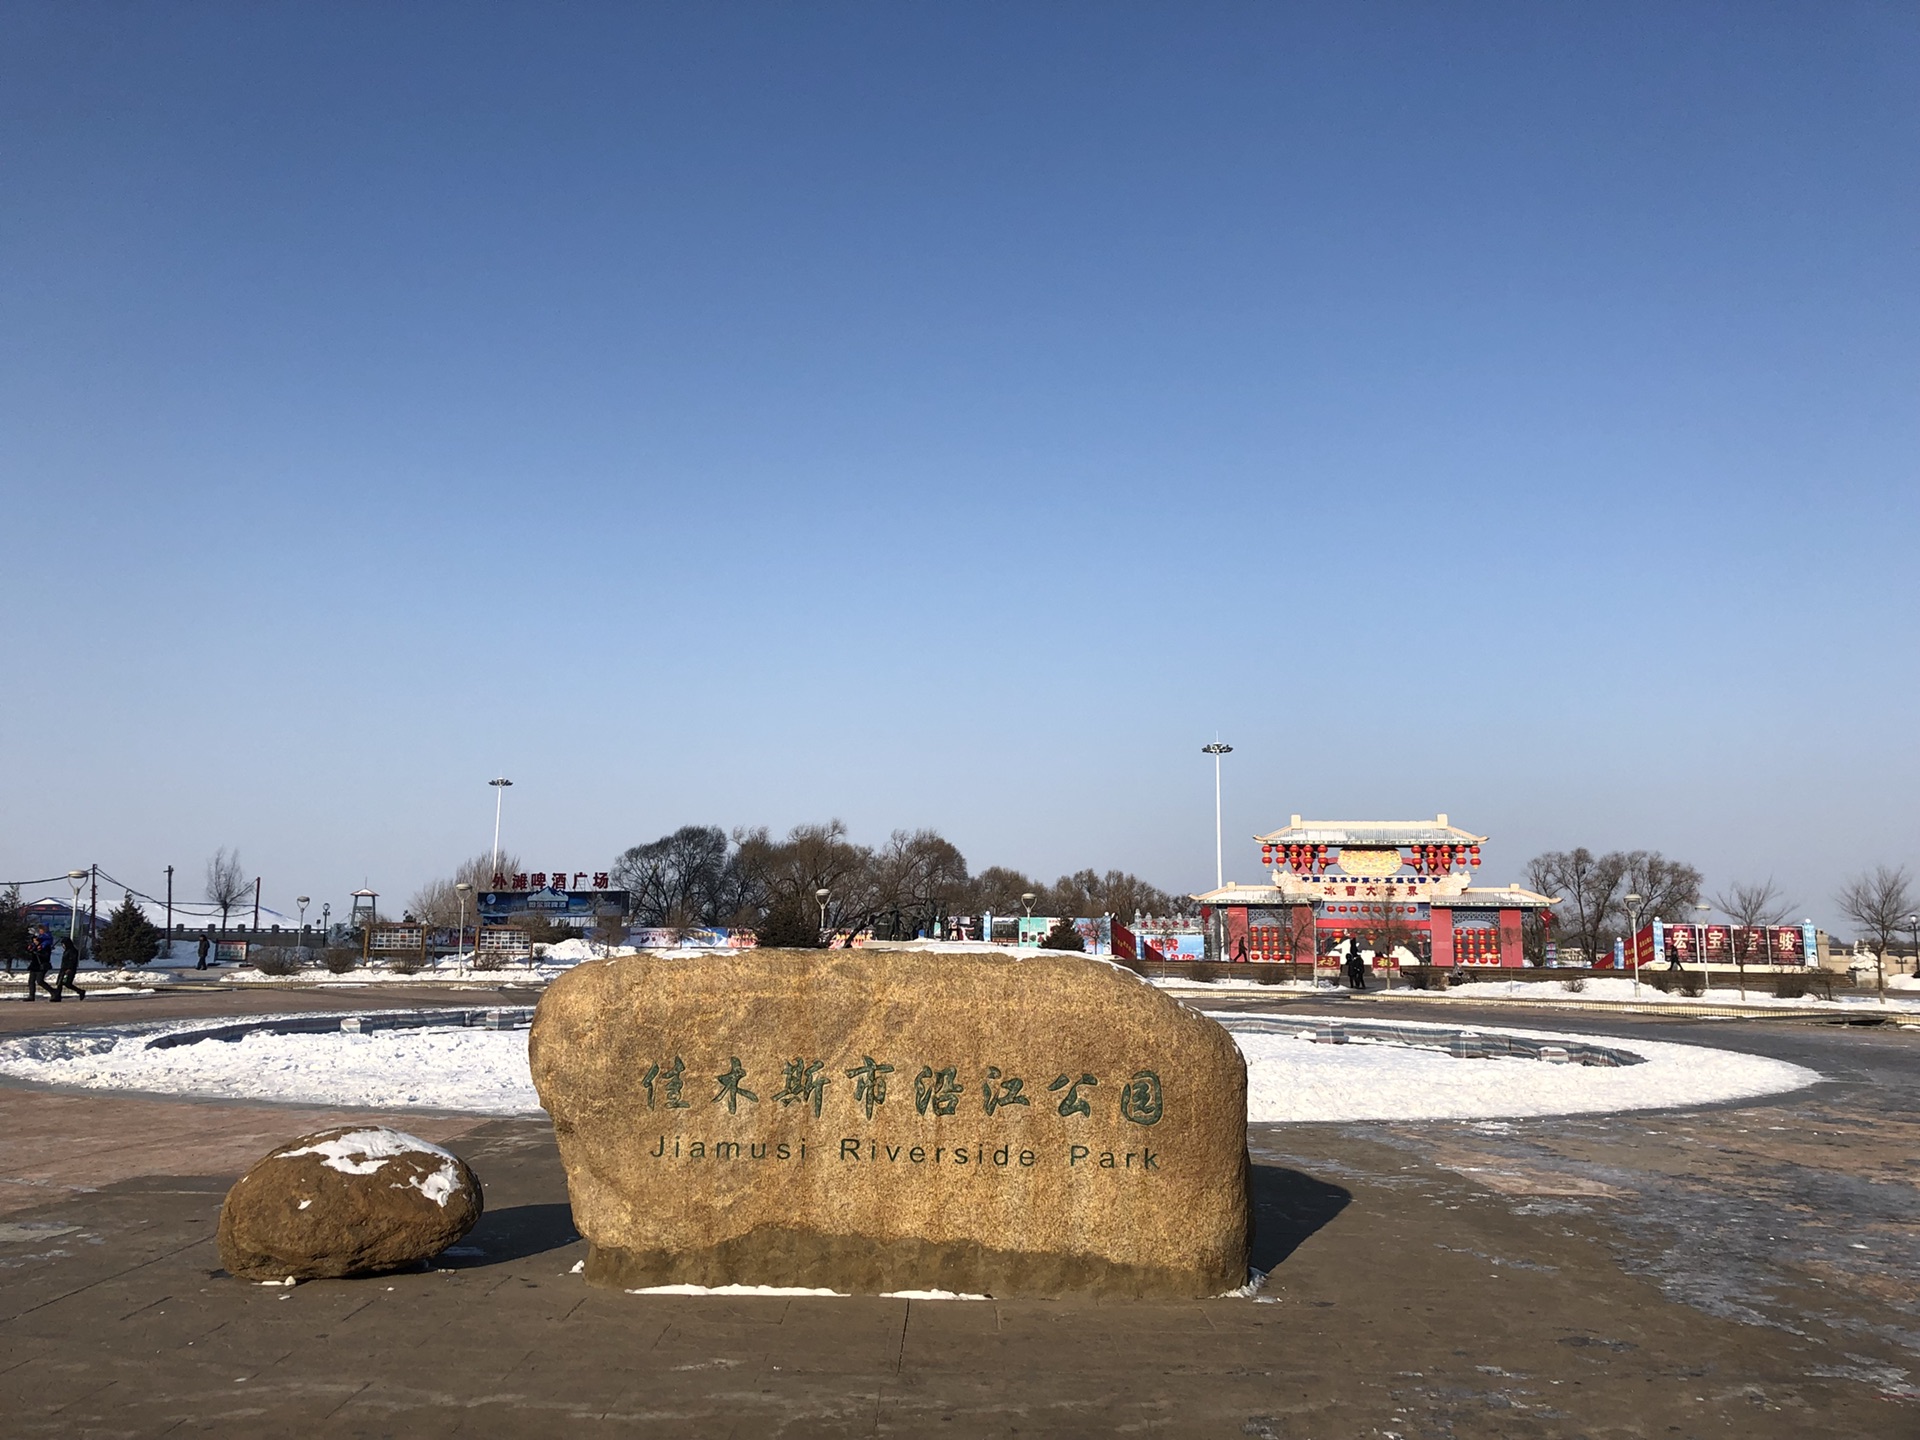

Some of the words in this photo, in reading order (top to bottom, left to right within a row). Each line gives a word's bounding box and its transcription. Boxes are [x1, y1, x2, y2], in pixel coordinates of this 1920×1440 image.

[492, 872, 609, 890] 外滩啤酒广场
[642, 1056, 1164, 1126] 佳木斯市沿江公园
[650, 1135, 808, 1161] Jiamusi
[840, 1139, 1036, 1167] Riverside
[1071, 1145, 1161, 1170] Park
